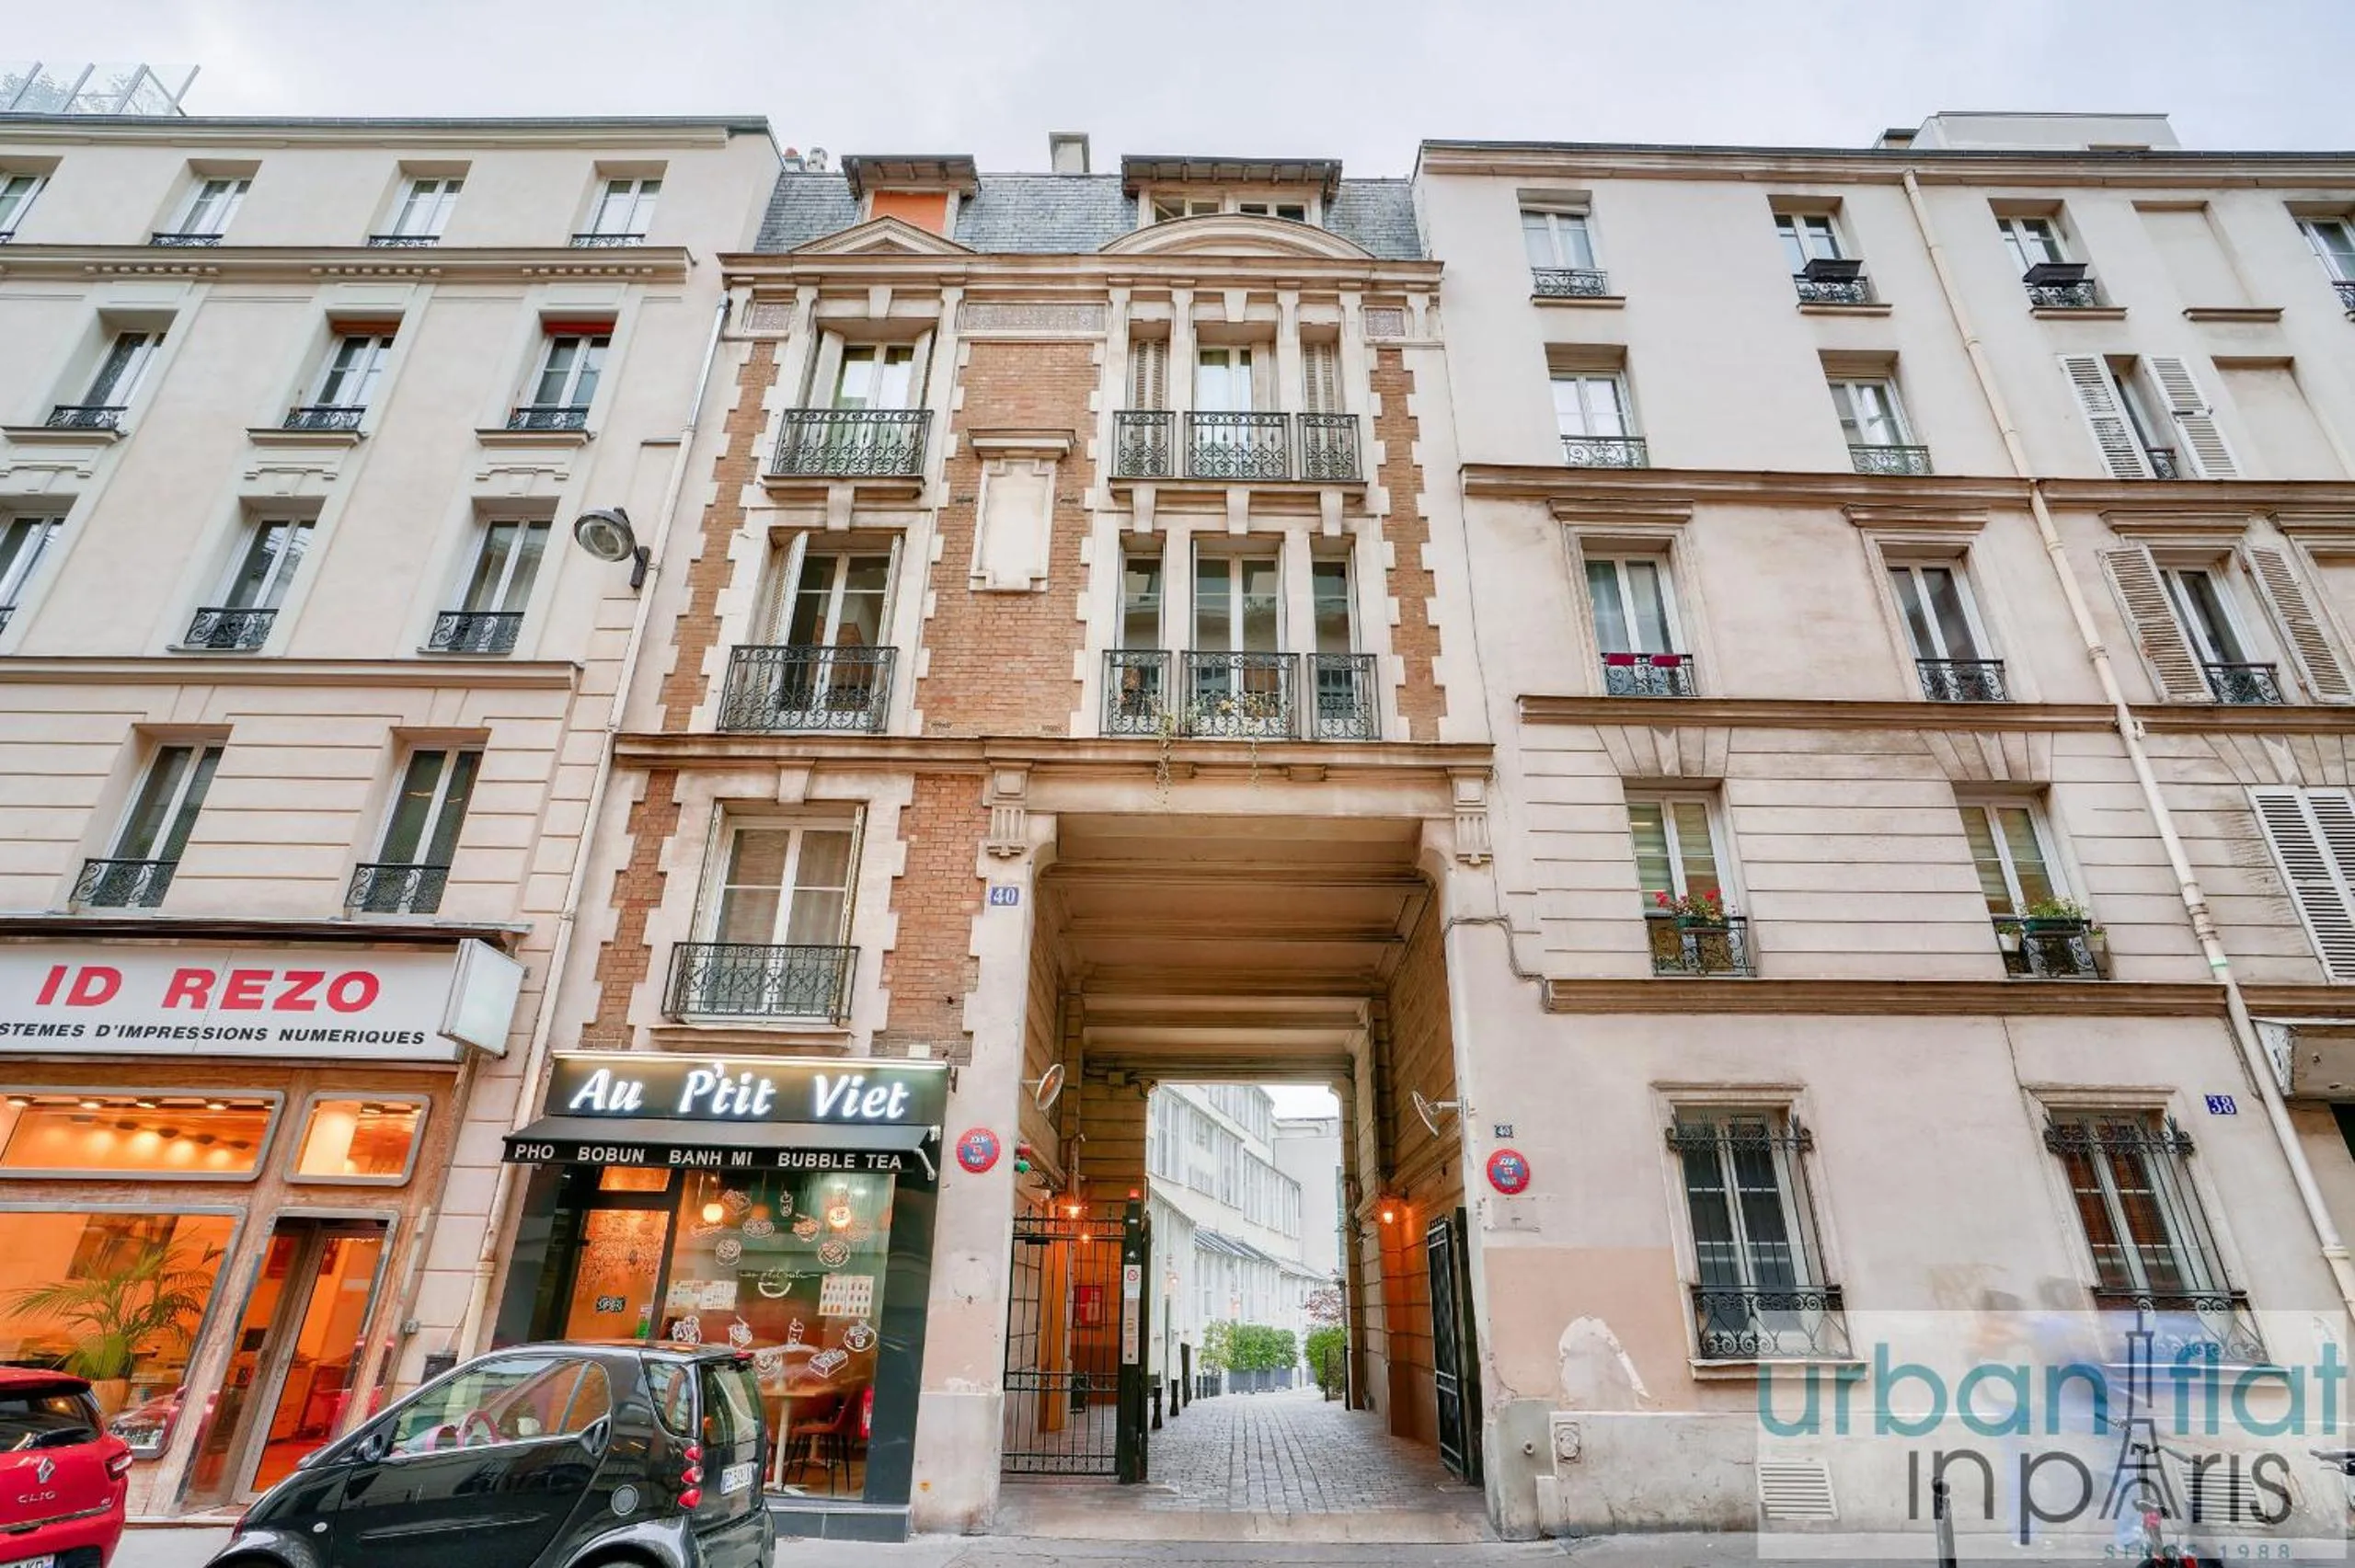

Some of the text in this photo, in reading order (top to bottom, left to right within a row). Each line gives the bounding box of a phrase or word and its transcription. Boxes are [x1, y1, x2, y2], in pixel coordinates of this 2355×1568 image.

[994, 888, 1017, 904] 40
[36, 965, 380, 1013] ID REZO
[96, 1024, 269, 1041] D'IMPRESSIONS
[279, 1028, 425, 1045] NUMERIQUES
[568, 1060, 910, 1119] Au P'tit Viet
[2208, 1096, 2235, 1114] 38
[514, 1143, 902, 1170] PHO BOBUN BANH MI BUBBLE TEA
[17, 1490, 57, 1505] CLIO
